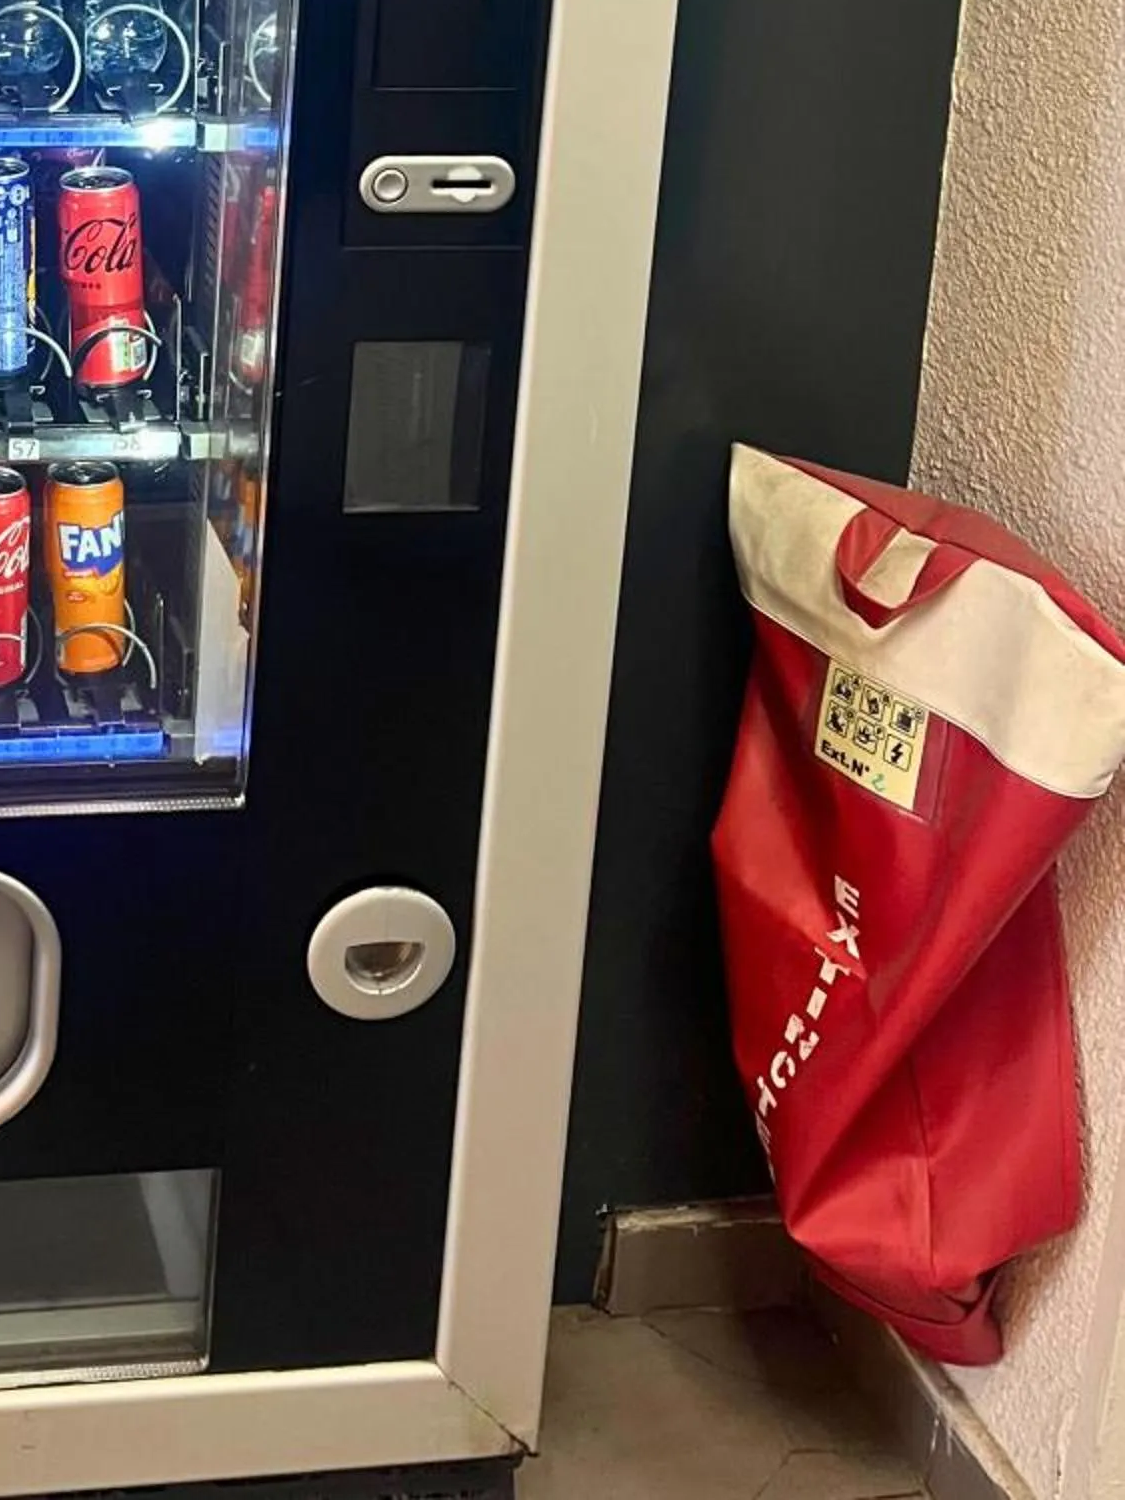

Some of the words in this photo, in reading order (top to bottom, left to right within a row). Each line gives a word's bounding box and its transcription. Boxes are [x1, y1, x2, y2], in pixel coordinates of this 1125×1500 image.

[64, 216, 137, 275] Cola
[12, 438, 36, 458] 57
[58, 512, 124, 562] FAN
